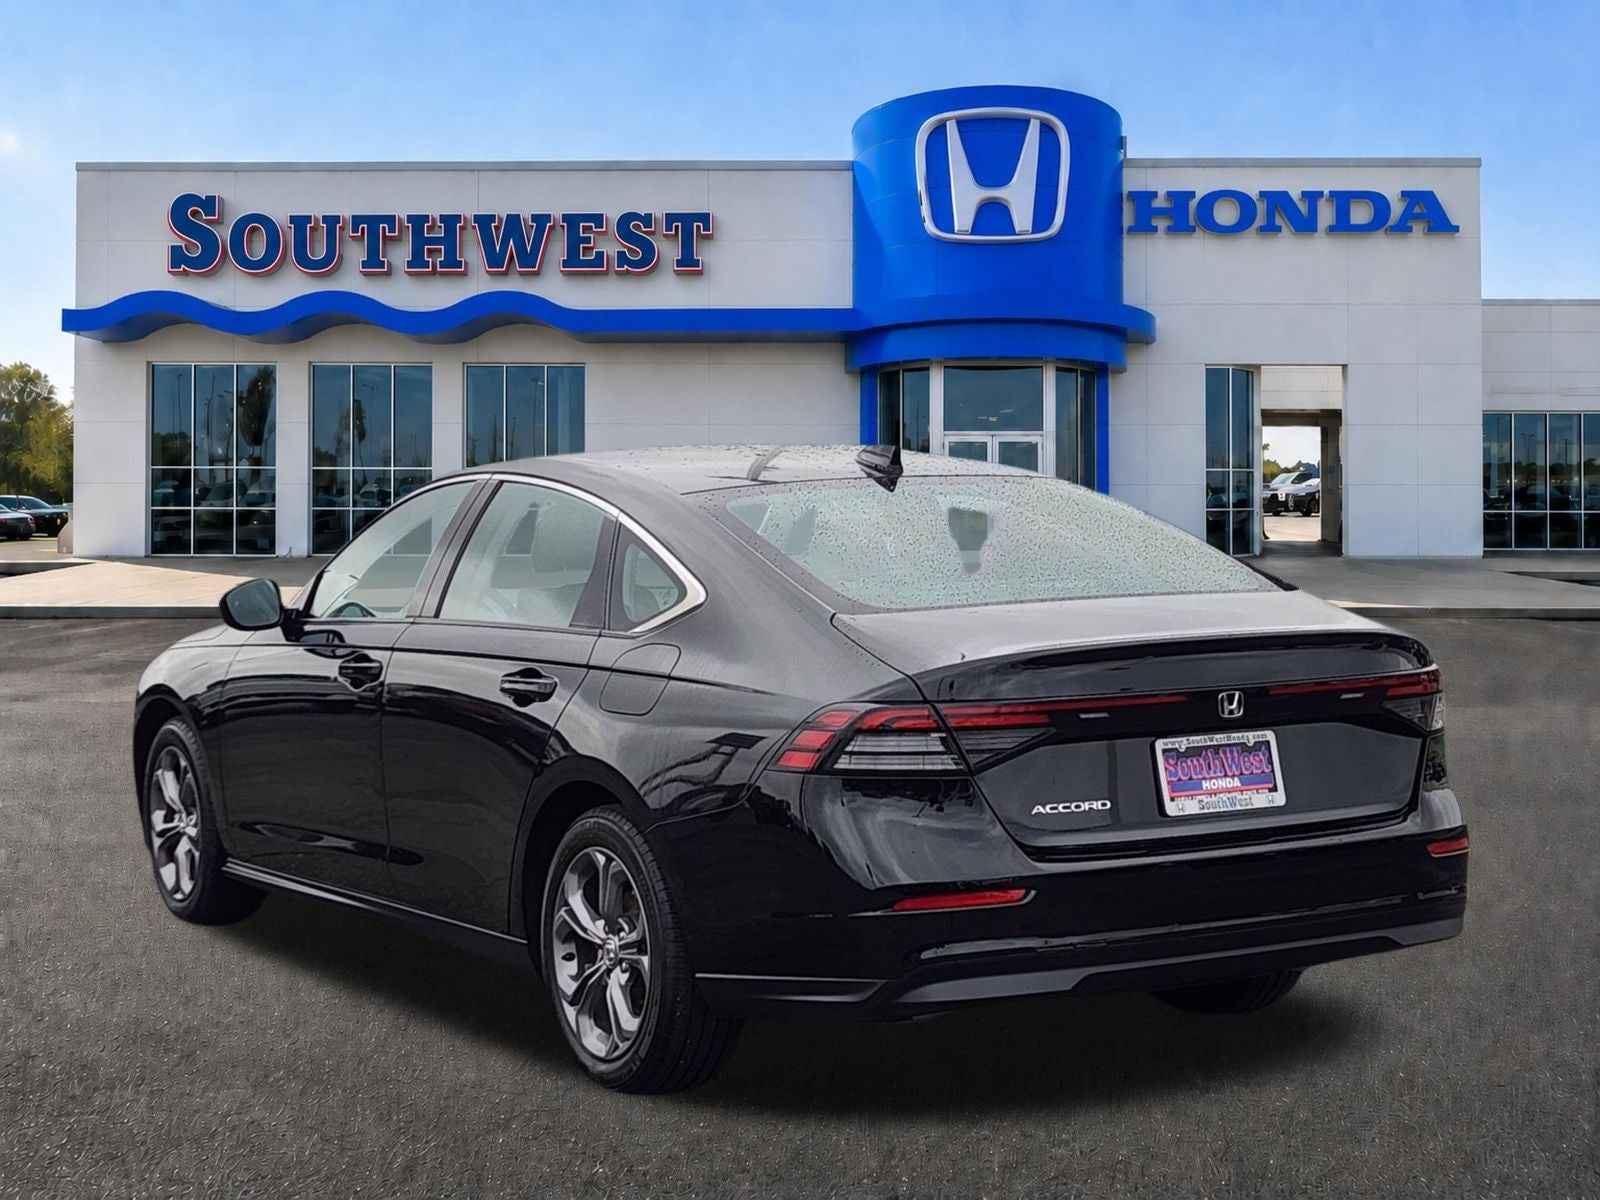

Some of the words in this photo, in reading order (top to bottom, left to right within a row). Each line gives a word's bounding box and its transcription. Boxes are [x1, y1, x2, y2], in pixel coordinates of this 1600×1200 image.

[1126, 189, 1460, 234] HONDA
[168, 192, 714, 274] SOUTHWEST
[1164, 746, 1271, 780] SouthWest
[1202, 777, 1241, 790] HONDA
[1031, 800, 1112, 815] ACCORD
[1199, 798, 1253, 811] SouthWest
